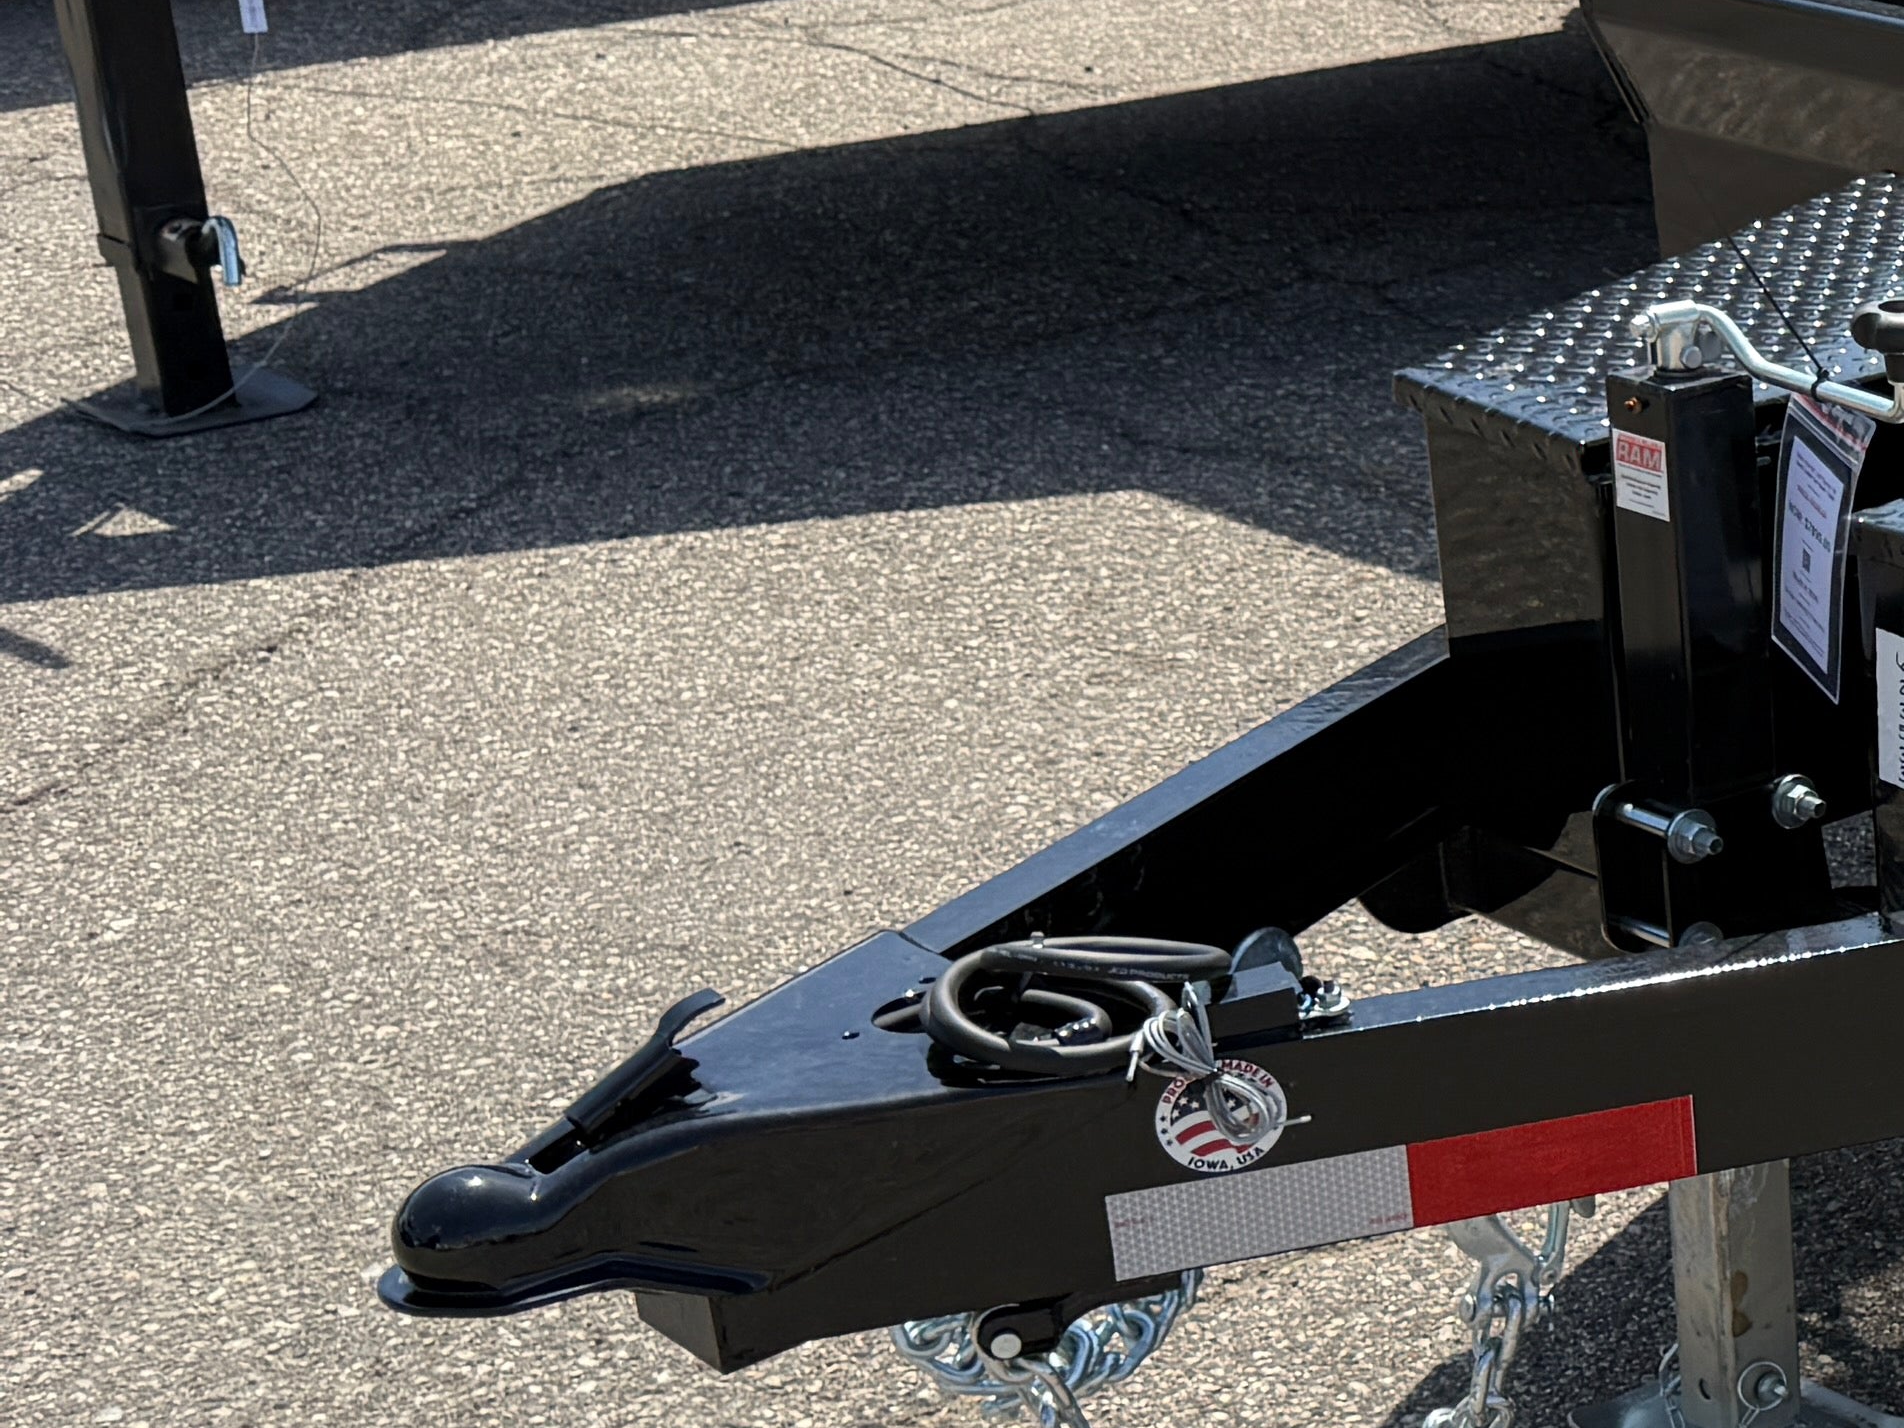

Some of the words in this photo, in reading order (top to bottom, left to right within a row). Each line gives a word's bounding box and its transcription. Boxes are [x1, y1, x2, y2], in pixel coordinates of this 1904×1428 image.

[1619, 442, 1660, 469] RAM
[1219, 1059, 1260, 1078] MADE
[1259, 1073, 1275, 1089] IN
[1187, 1156, 1234, 1172] IOWA,
[1236, 1147, 1265, 1165] USA
